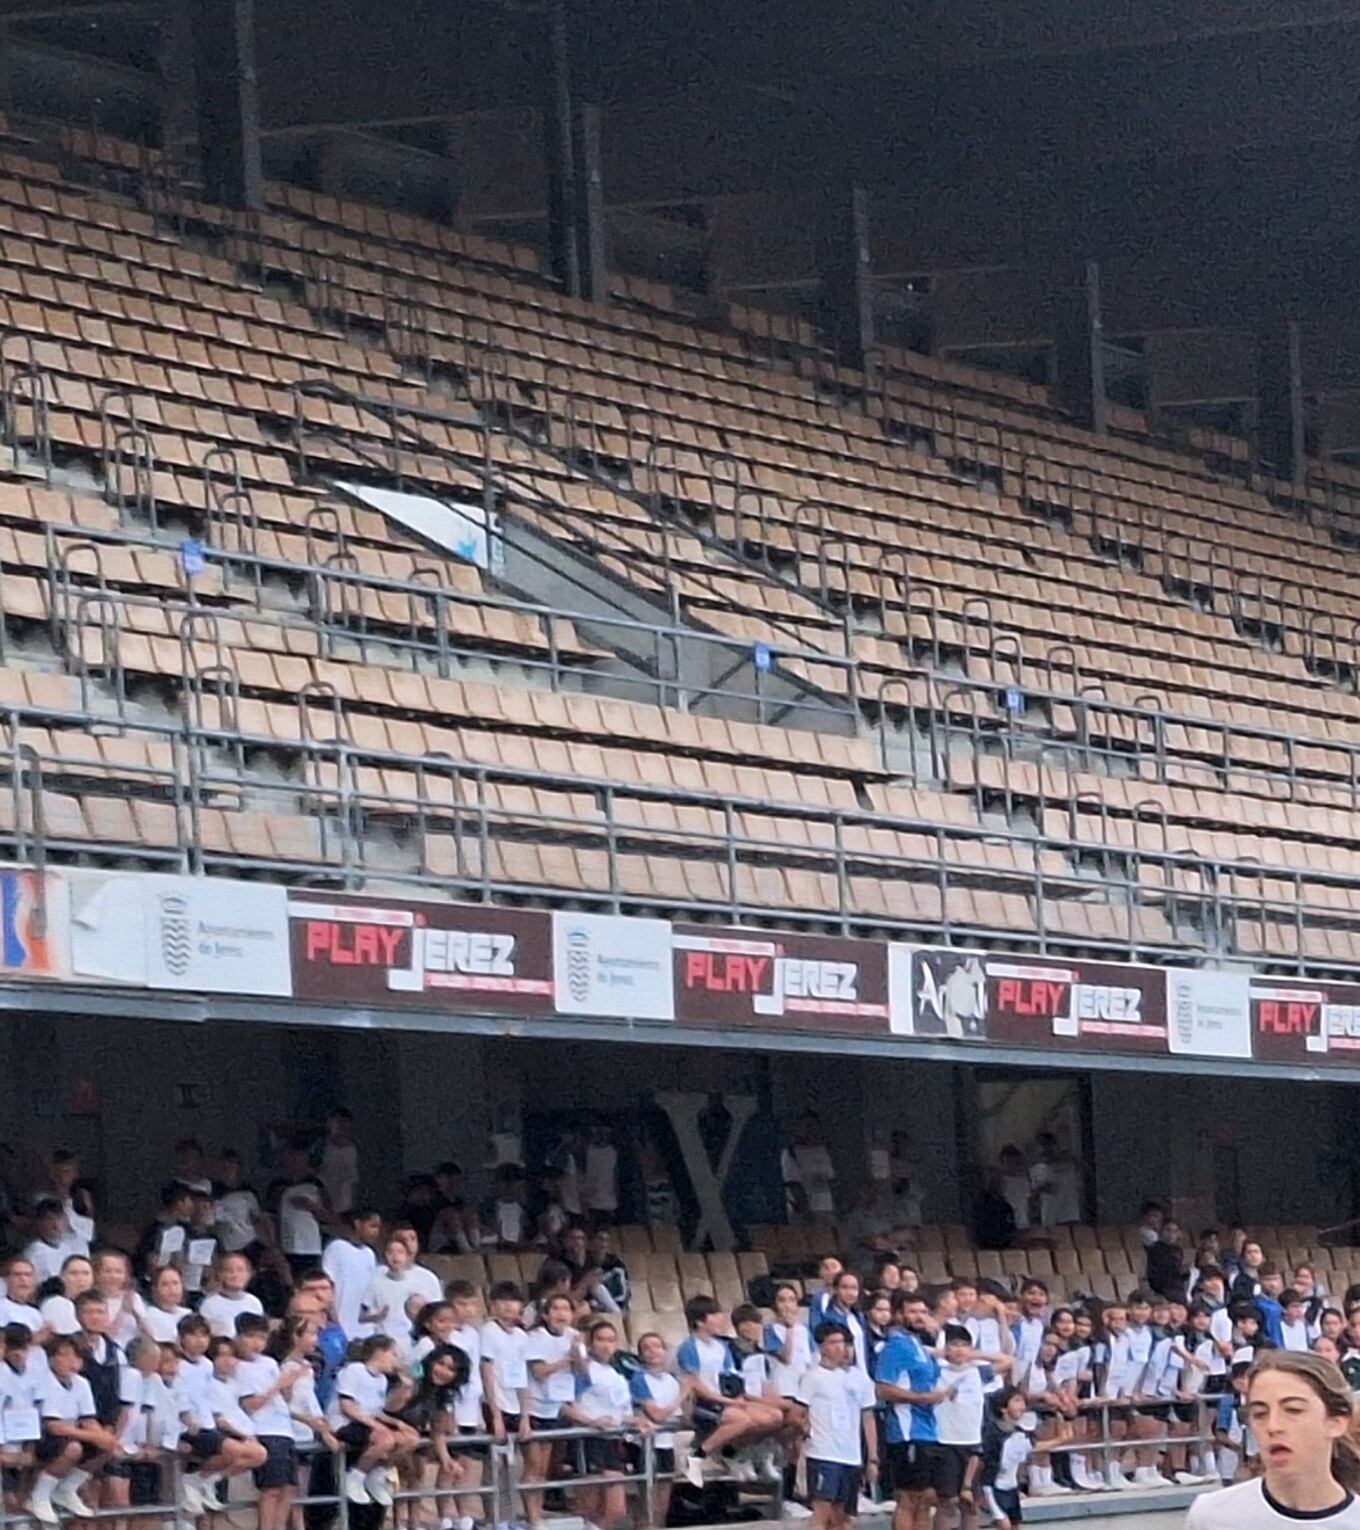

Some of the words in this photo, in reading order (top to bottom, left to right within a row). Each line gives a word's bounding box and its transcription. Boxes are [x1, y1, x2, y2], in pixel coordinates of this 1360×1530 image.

[307, 921, 404, 967] PLAY
[685, 953, 769, 993] PLAY
[998, 979, 1066, 1017] PLAY
[1258, 1002, 1317, 1035] PLAY
